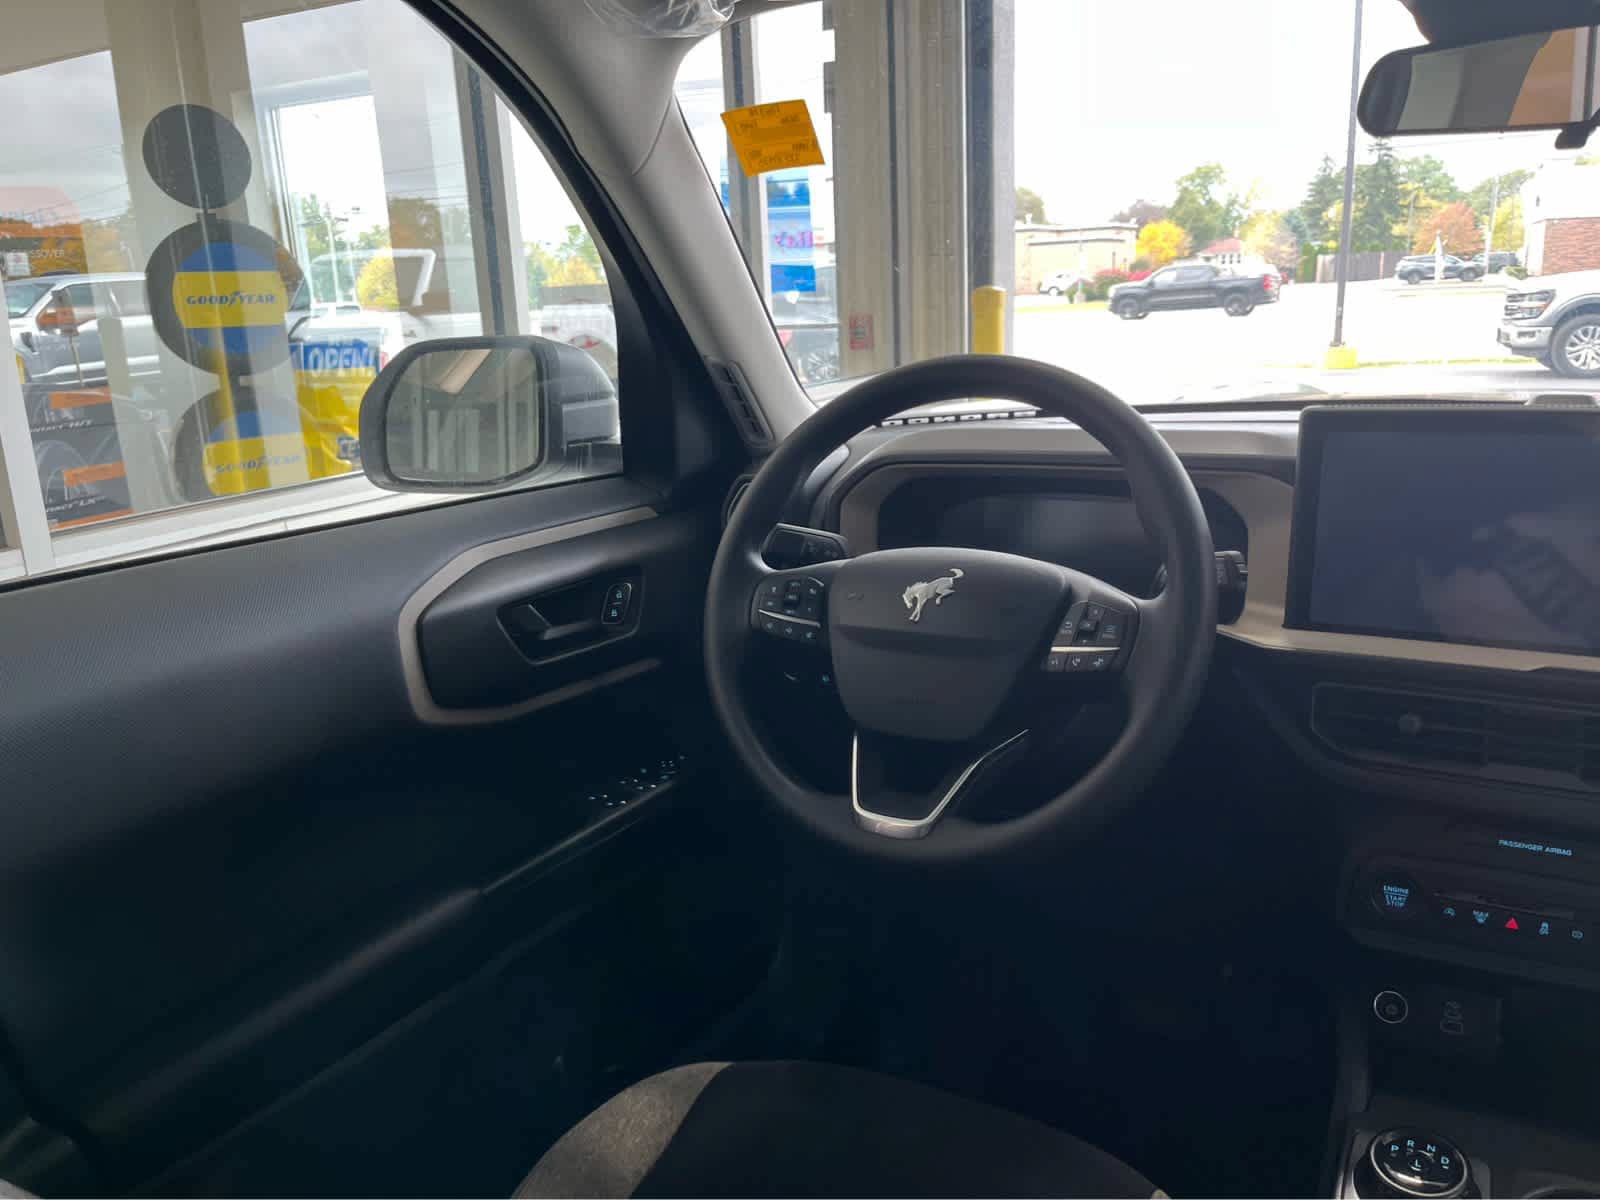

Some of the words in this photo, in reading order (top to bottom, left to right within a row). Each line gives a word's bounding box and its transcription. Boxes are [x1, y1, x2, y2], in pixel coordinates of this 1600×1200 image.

[186, 290, 276, 309] GOODYEAR
[1499, 839, 1543, 851] PASSENGER
[1545, 845, 1572, 856] AIRBAG
[1383, 885, 1409, 895] ENGINE
[1385, 894, 1407, 903] START
[1391, 1144, 1399, 1152] P
[1407, 1139, 1415, 1148] R
[1427, 1144, 1436, 1152] N
[1441, 1156, 1449, 1165] D
[1415, 1159, 1421, 1167] L
